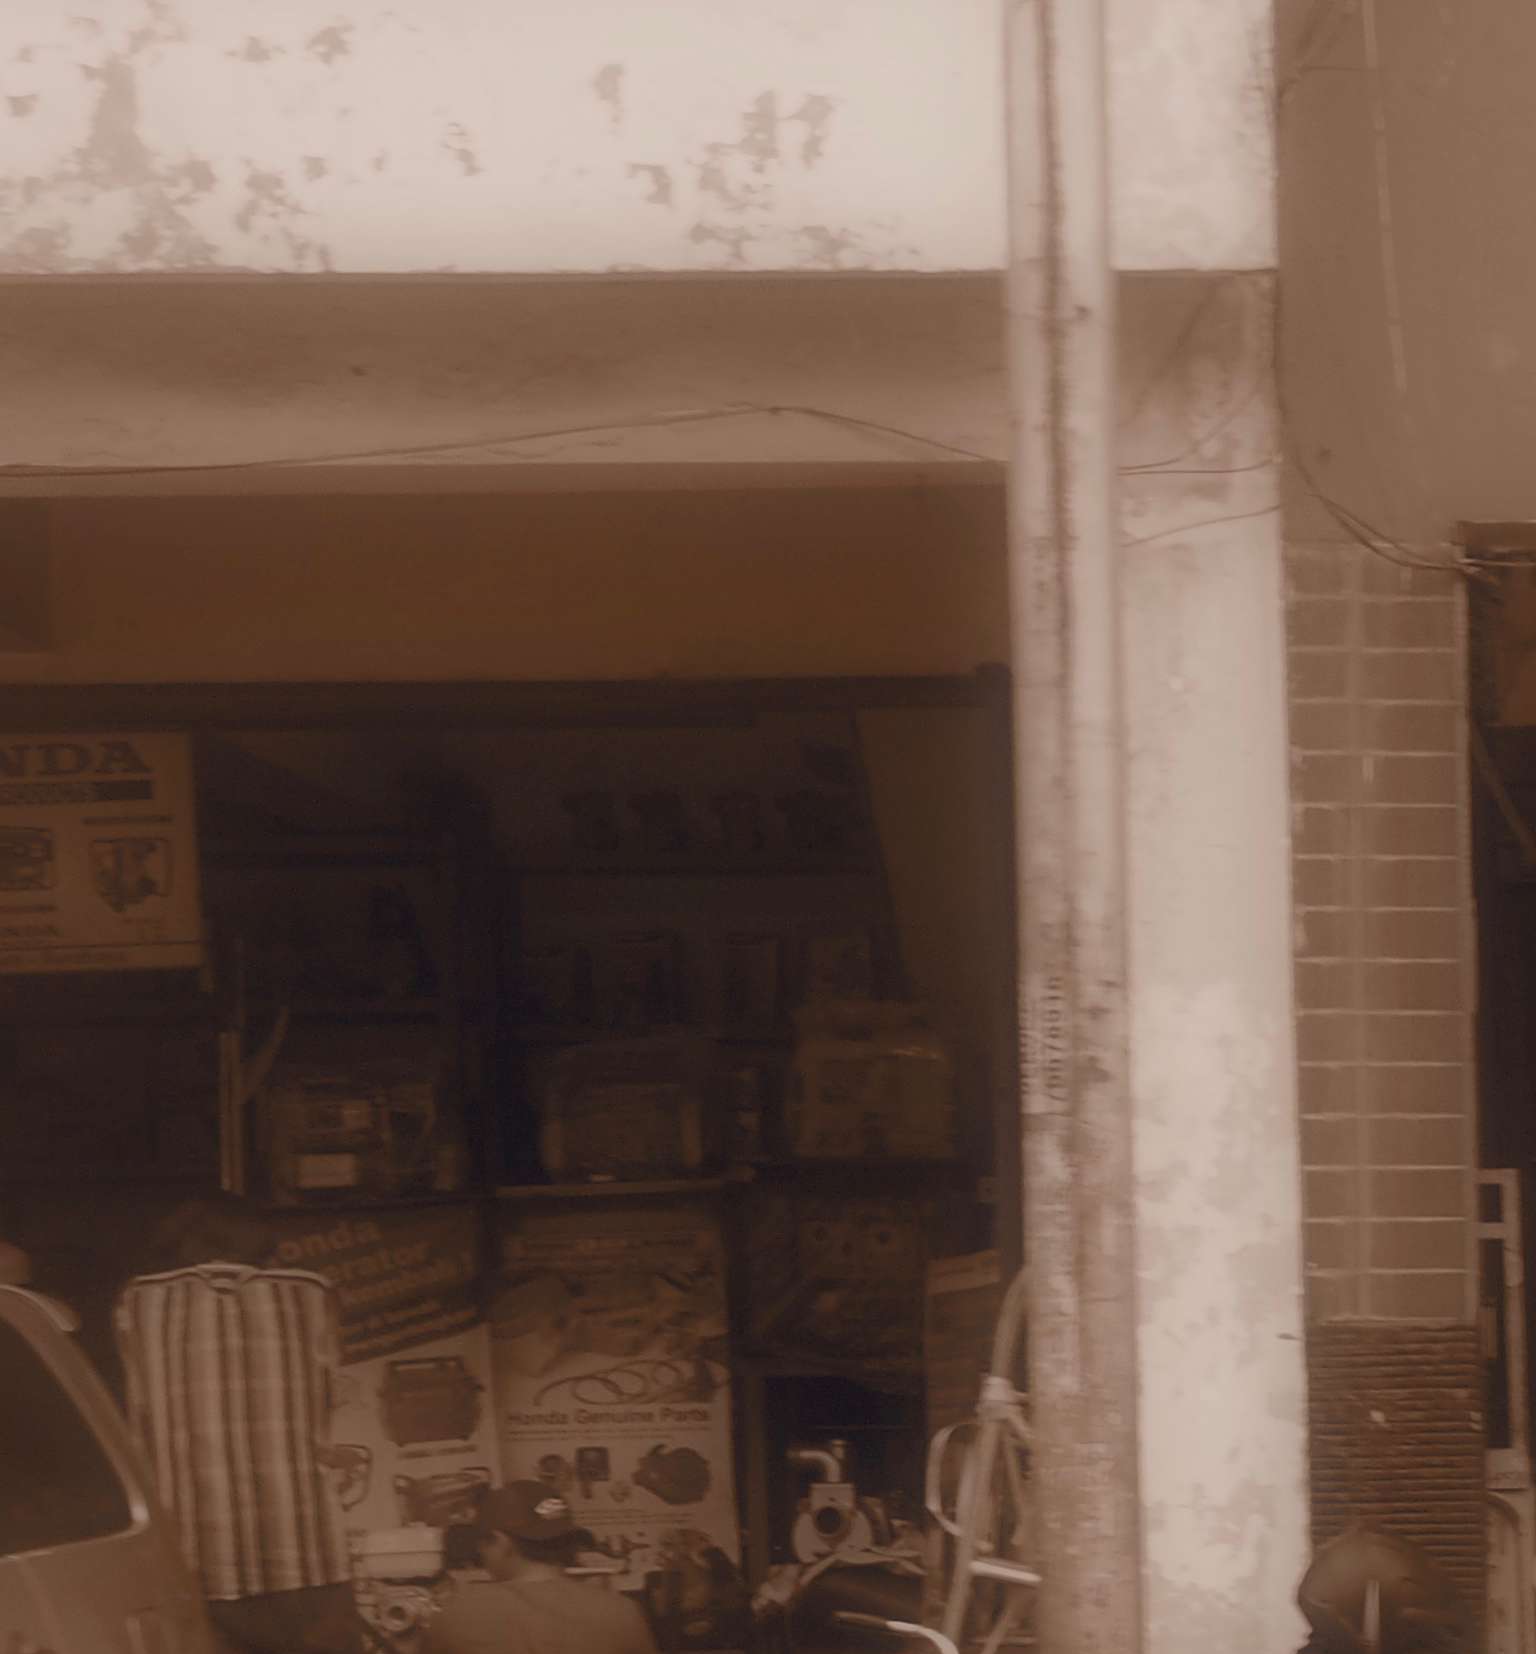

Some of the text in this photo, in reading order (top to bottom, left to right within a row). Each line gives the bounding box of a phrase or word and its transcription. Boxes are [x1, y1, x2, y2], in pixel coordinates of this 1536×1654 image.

[268, 1221, 382, 1264] onda
[505, 1409, 569, 1426] Honda
[574, 1407, 655, 1425] Genuine
